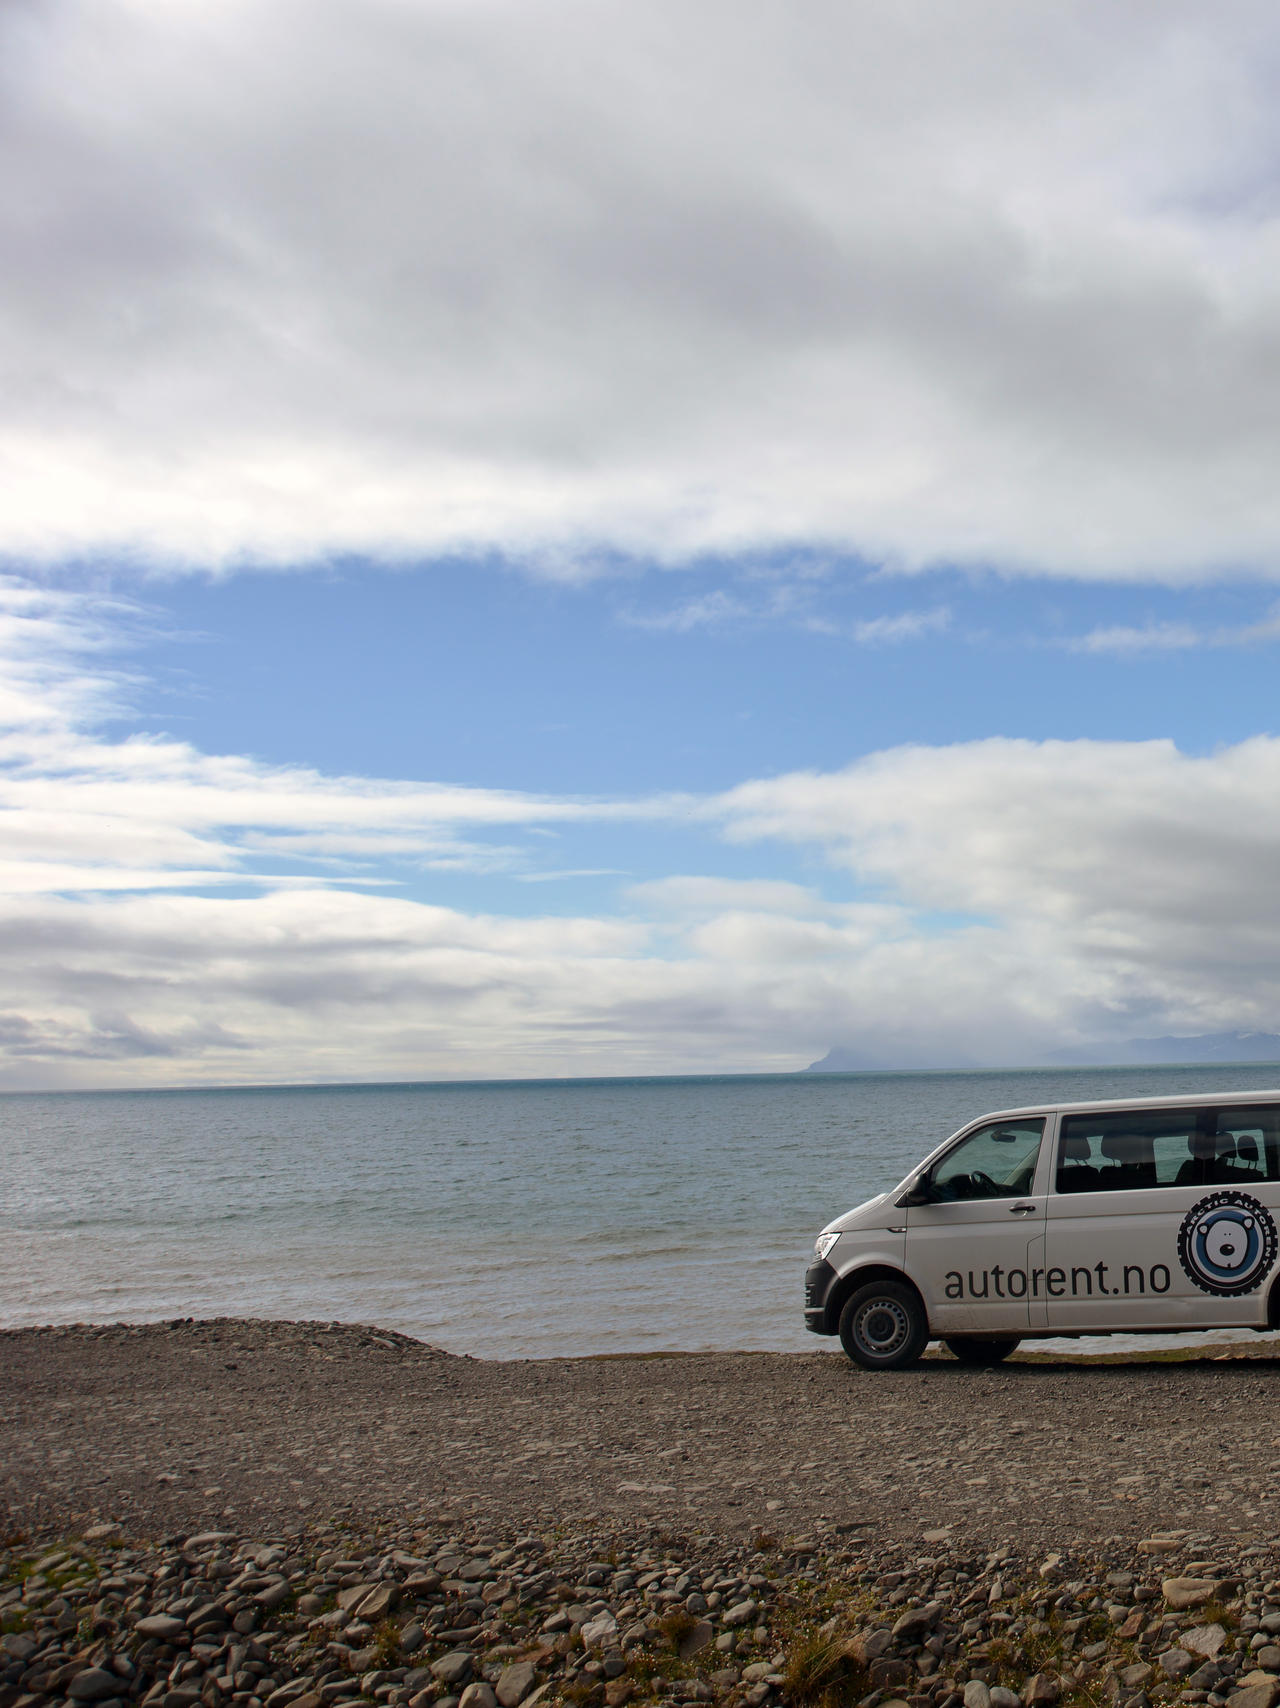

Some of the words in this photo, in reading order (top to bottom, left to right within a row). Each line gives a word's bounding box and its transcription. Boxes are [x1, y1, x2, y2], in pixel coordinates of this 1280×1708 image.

[1186, 1198, 1229, 1235] ARCTIC
[1234, 1199, 1272, 1267] AUTORENT
[944, 1260, 1171, 1299] autorent.no
